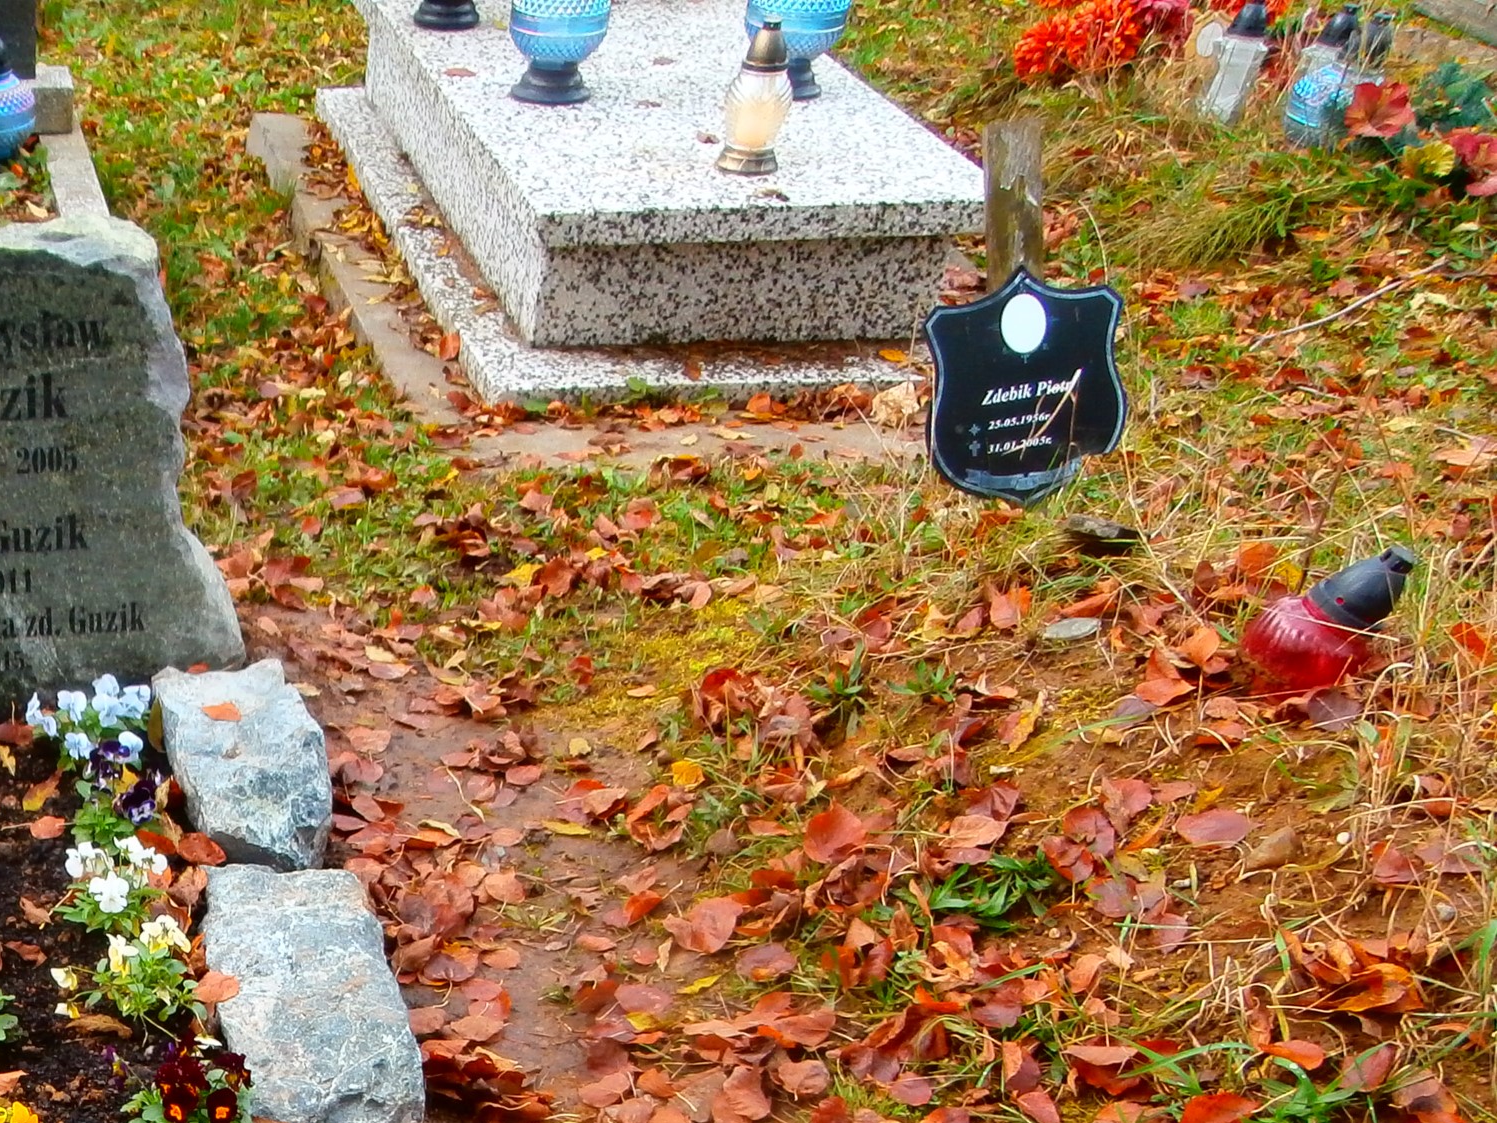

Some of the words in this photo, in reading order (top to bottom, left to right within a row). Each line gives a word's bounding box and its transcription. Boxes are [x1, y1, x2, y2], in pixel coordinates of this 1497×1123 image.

[981, 383, 1032, 406] Zdebik
[1035, 380, 1075, 397] Piotr
[16, 445, 78, 474] 2005
[25, 606, 61, 637] zd.
[69, 601, 145, 634] Guzik
